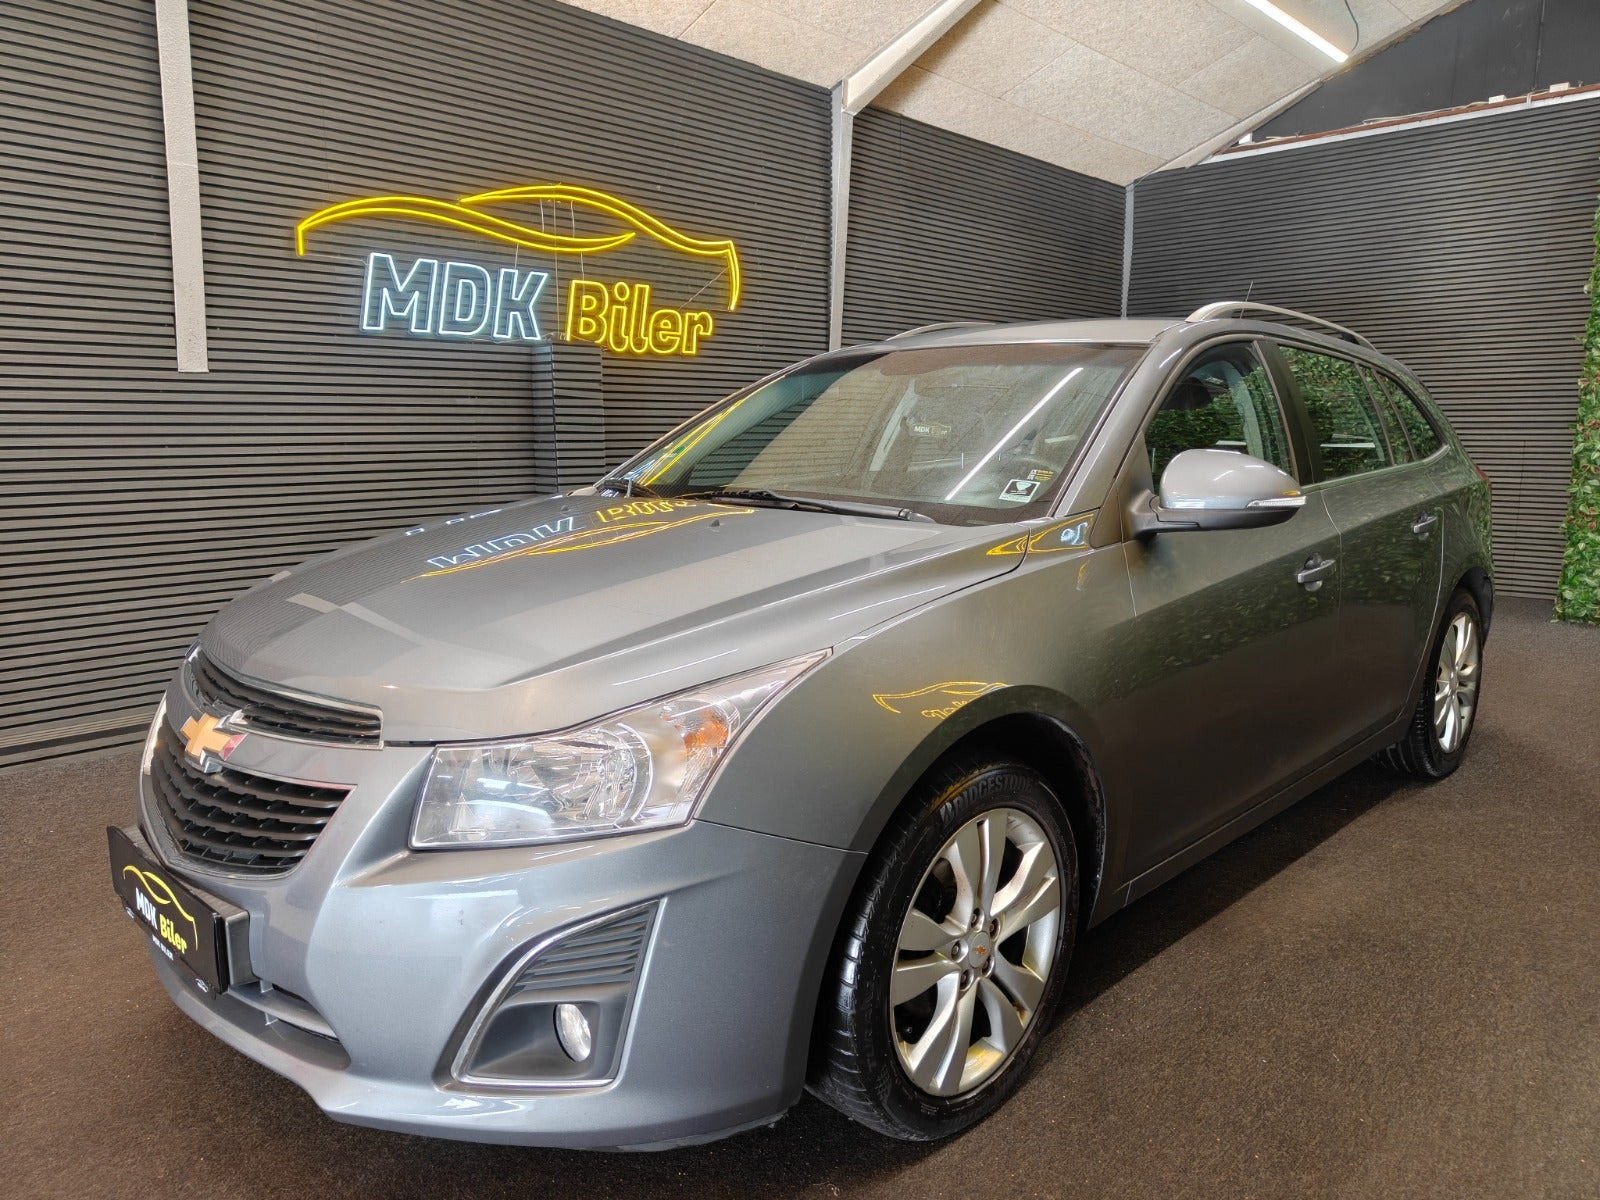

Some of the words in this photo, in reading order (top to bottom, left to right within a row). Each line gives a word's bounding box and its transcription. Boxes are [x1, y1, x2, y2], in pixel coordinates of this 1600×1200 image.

[362, 251, 549, 341] MDK
[566, 279, 713, 355] Biler
[135, 887, 158, 930] MDK
[159, 913, 188, 954] Biler
